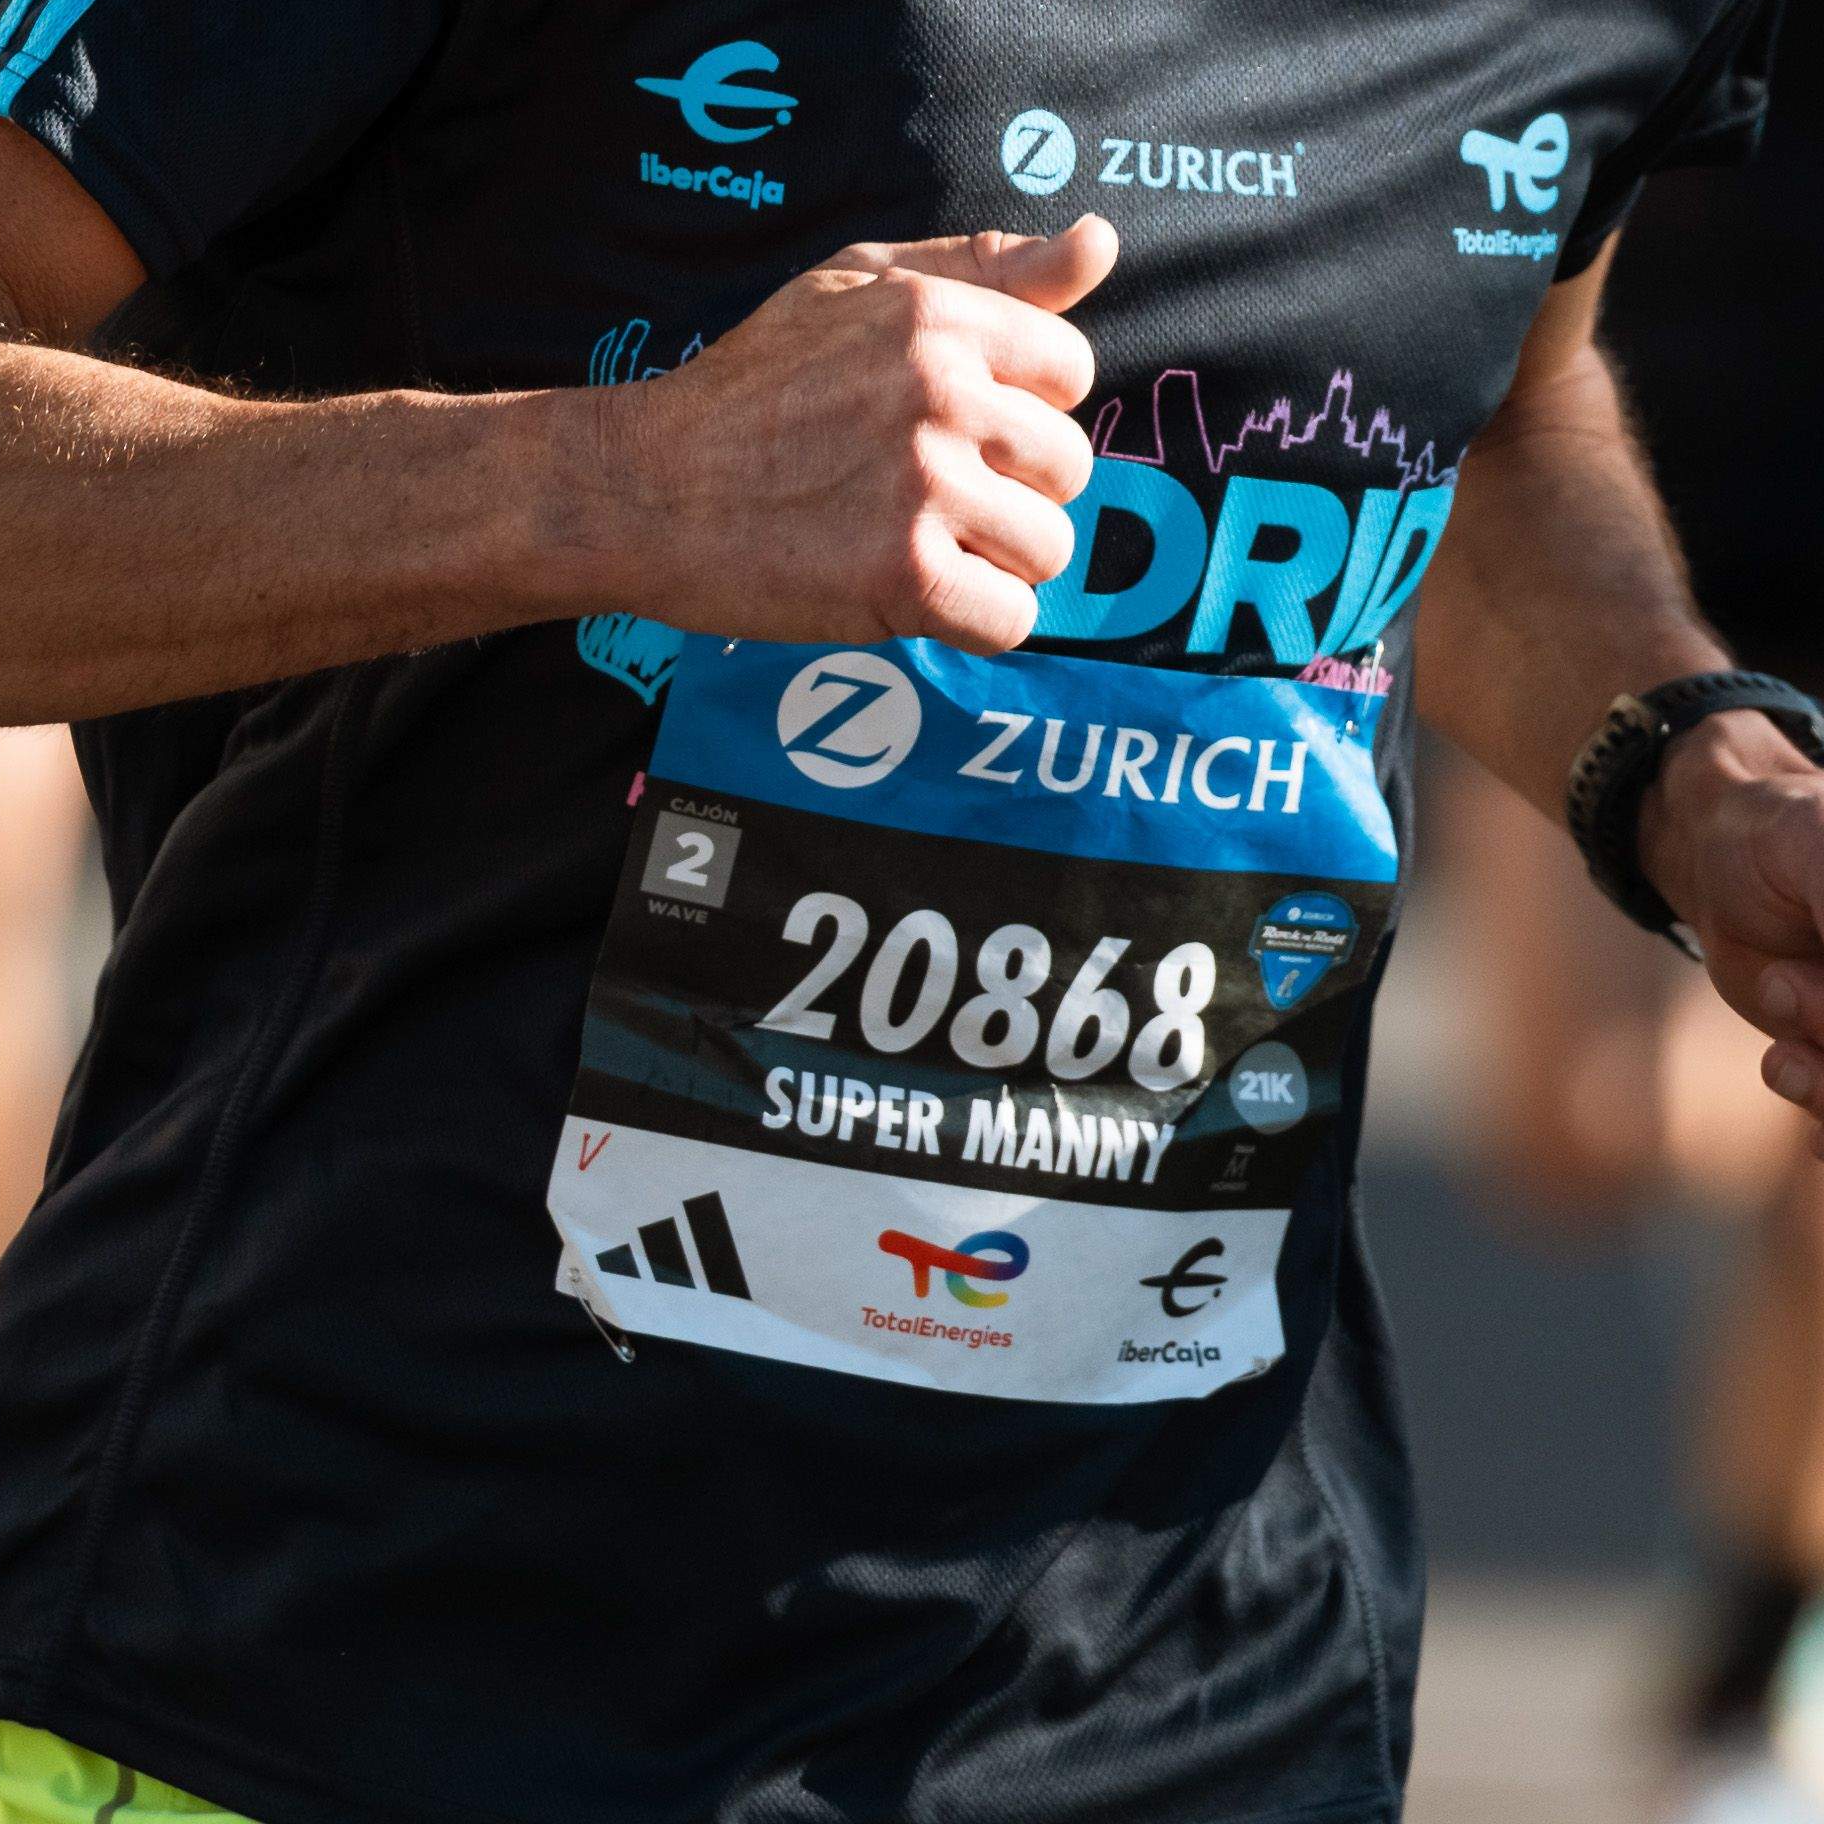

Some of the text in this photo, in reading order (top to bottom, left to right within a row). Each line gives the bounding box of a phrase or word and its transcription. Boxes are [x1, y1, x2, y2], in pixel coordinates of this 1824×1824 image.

[1098, 138, 1298, 198] ZURICH
[1030, 455, 1455, 666] DRID
[956, 709, 1309, 815] ZURICH
[670, 797, 738, 825] CAJÓN
[665, 831, 715, 887] 2
[648, 899, 709, 924] WAVE
[753, 891, 1217, 1093] 20868
[1238, 1070, 1294, 1105] 21K
[761, 1066, 1175, 1185] SUPER MANNY
[861, 1307, 1014, 1349] TotalEnergies
[1117, 1339, 1221, 1367] iberCaja
